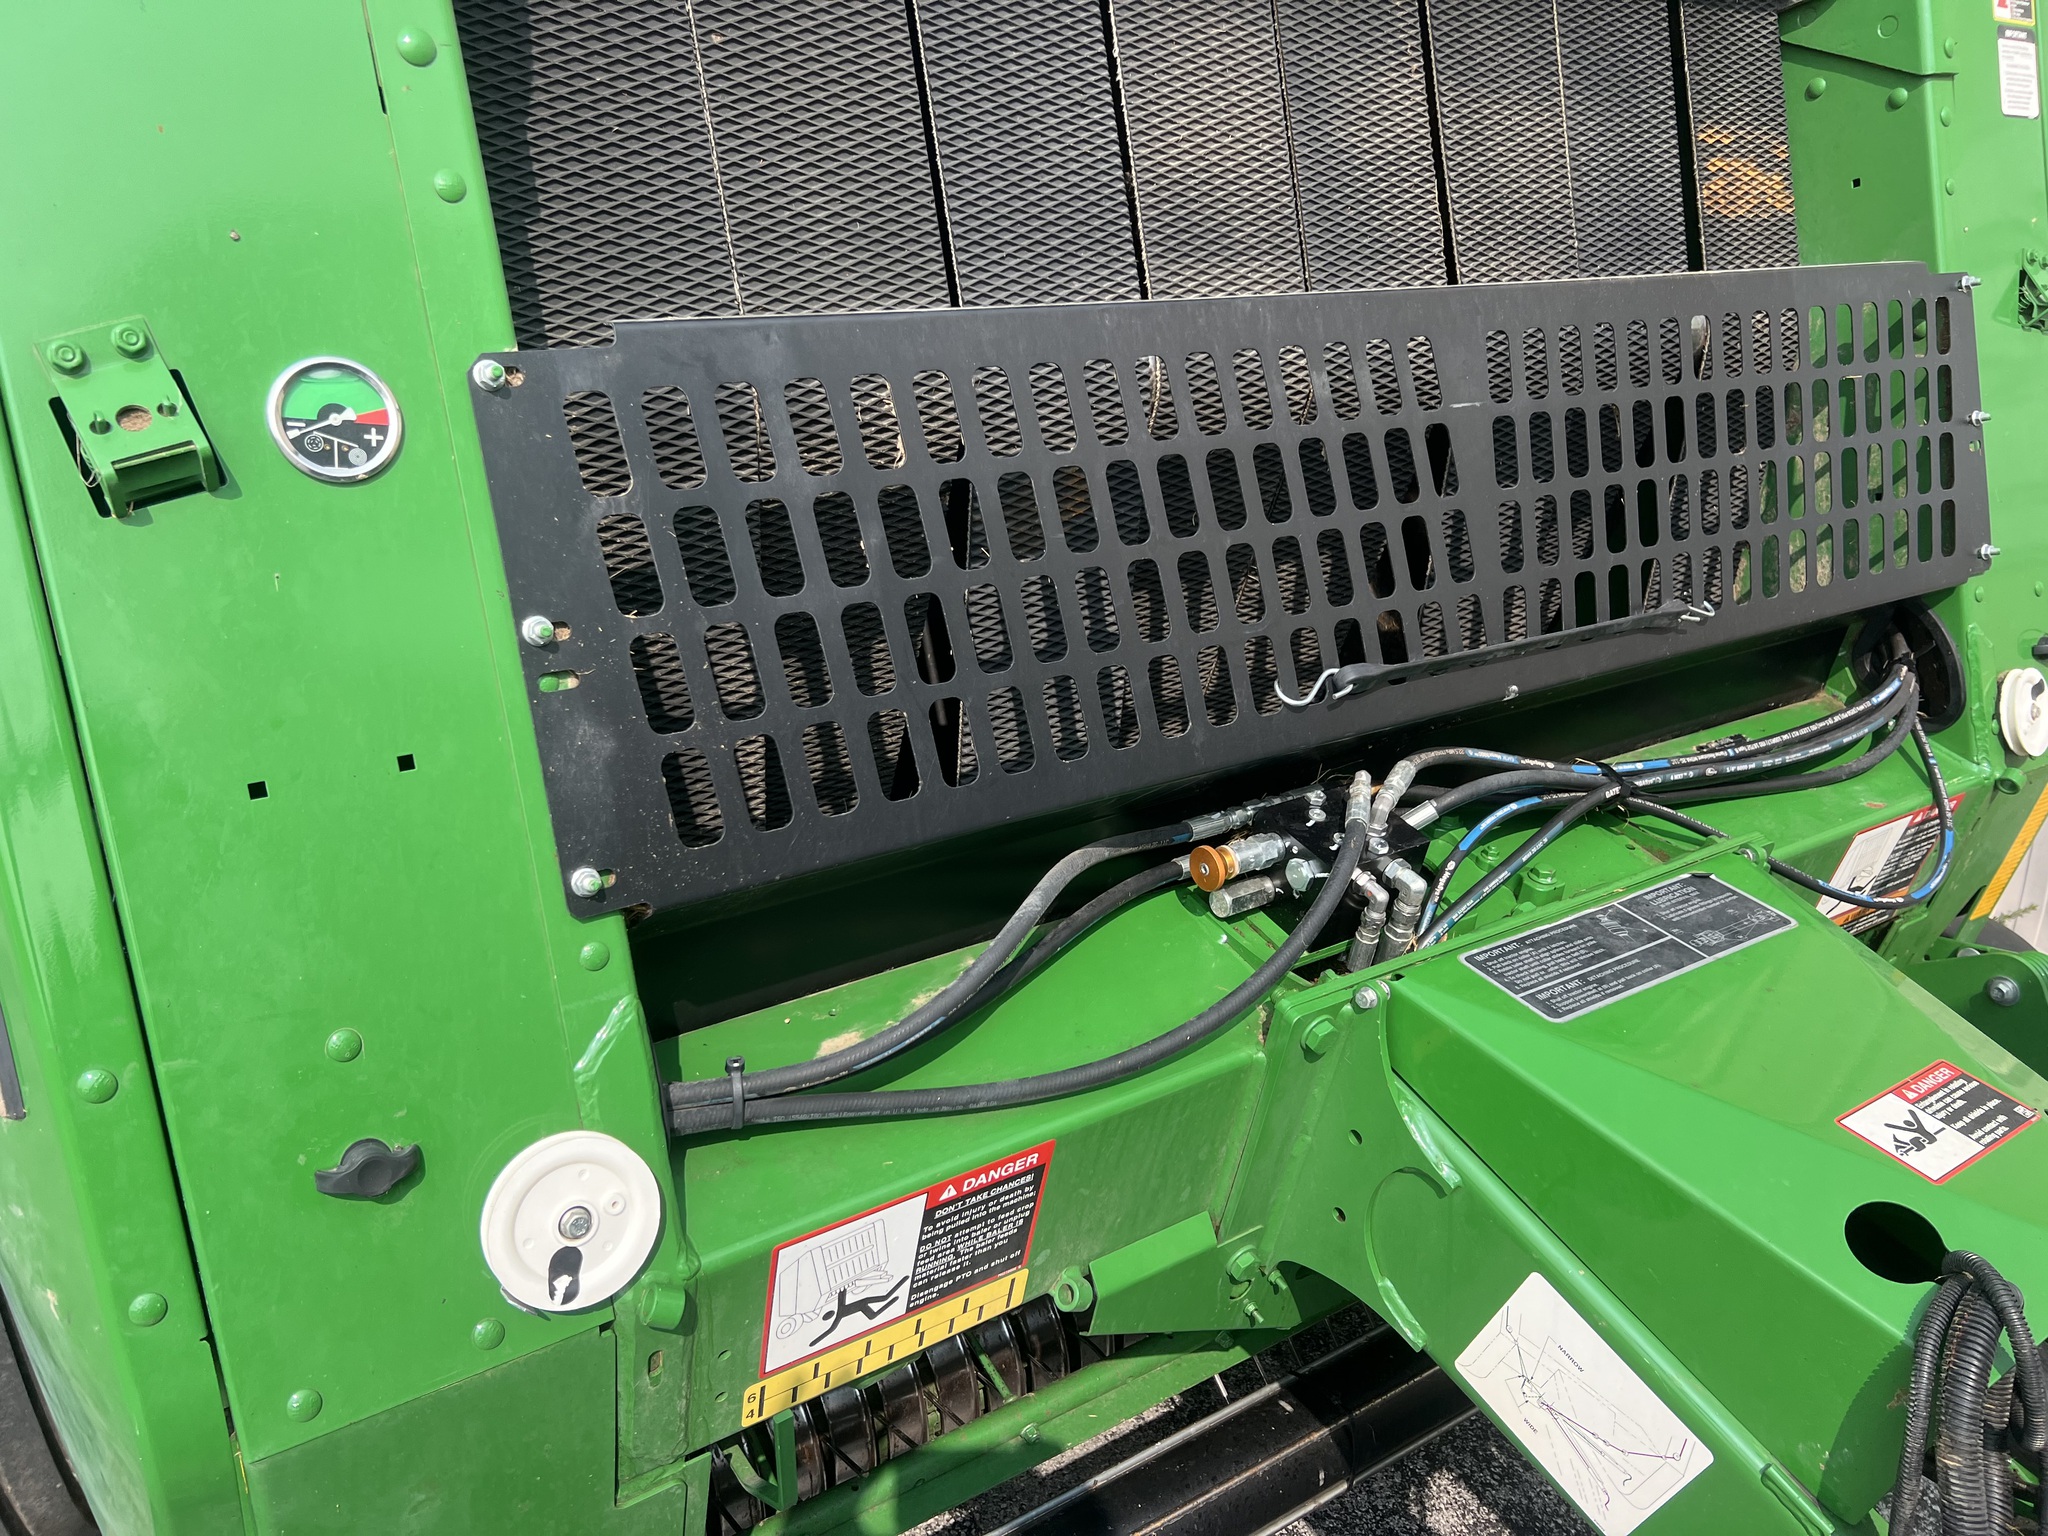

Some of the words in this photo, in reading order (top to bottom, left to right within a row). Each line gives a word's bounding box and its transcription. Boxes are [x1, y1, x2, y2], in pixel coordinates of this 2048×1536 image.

[1474, 943, 1523, 961] IMPORTANT:
[1536, 979, 1585, 1000] IMPORTANT:
[1914, 1067, 1955, 1095] DANGER
[963, 1154, 1038, 1191] DANGER
[934, 1201, 963, 1219] DON'T
[964, 1191, 988, 1207] TAKE
[989, 1174, 1034, 1197] CHANCES!
[936, 1214, 959, 1228] avoid
[962, 1204, 986, 1217] injury
[1000, 1190, 1022, 1202] death
[920, 1243, 932, 1253] DO
[935, 1235, 952, 1247] NOT
[954, 1222, 985, 1238] attempt
[998, 1209, 1015, 1220] feed
[1017, 1202, 1034, 1214] crop
[922, 1228, 944, 1240] being
[946, 1216, 970, 1232] pulled
[972, 1211, 987, 1220] into
[989, 1205, 1001, 1213] the
[930, 1243, 951, 1255] twine
[953, 1235, 969, 1245] into
[971, 1226, 991, 1238] baler
[1004, 1210, 1030, 1226] unplug
[914, 1263, 947, 1281] material
[950, 1253, 972, 1266] faster
[975, 1245, 992, 1256] than
[994, 1239, 1008, 1249] you
[916, 1254, 955, 1275] RUNNING.
[960, 1247, 974, 1255] The
[976, 1237, 995, 1249] baler
[997, 1228, 1017, 1240] feeds
[917, 1255, 935, 1266] feed
[937, 1248, 955, 1258] area
[957, 1235, 983, 1251] WHILE
[986, 1223, 1013, 1239] BALER
[1015, 1219, 1023, 1227] IS
[911, 1280, 953, 1301] Disengage
[956, 1271, 972, 1282] PTO
[974, 1264, 989, 1274] and
[991, 1256, 1008, 1267] shut
[1010, 1250, 1021, 1259] off
[913, 1279, 928, 1288] can
[931, 1265, 960, 1280] release
[910, 1293, 939, 1307] engine.
[1558, 1345, 1584, 1372] NARROW
[746, 1409, 755, 1419] 4
[747, 1393, 756, 1403] 6
[1523, 1417, 1538, 1434] WIDE
